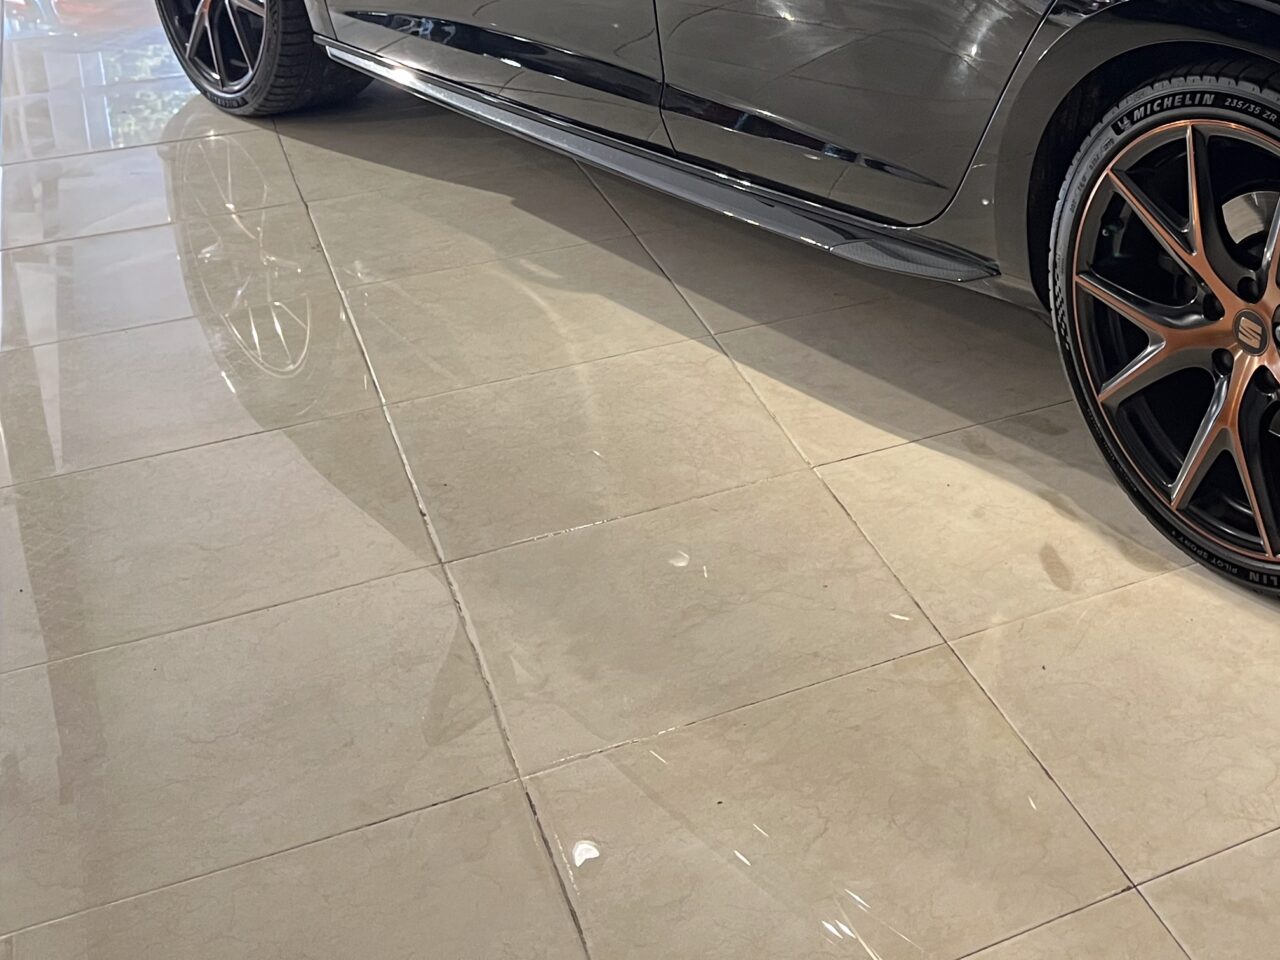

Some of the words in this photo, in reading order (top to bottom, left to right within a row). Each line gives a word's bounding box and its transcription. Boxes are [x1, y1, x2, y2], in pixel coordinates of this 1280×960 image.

[1133, 93, 1215, 121] MICHELIN
[1224, 97, 1260, 114] 235/35
[1261, 110, 1278, 122] ZR
[1178, 535, 1209, 559] SPORT
[1211, 558, 1238, 574] PILOT
